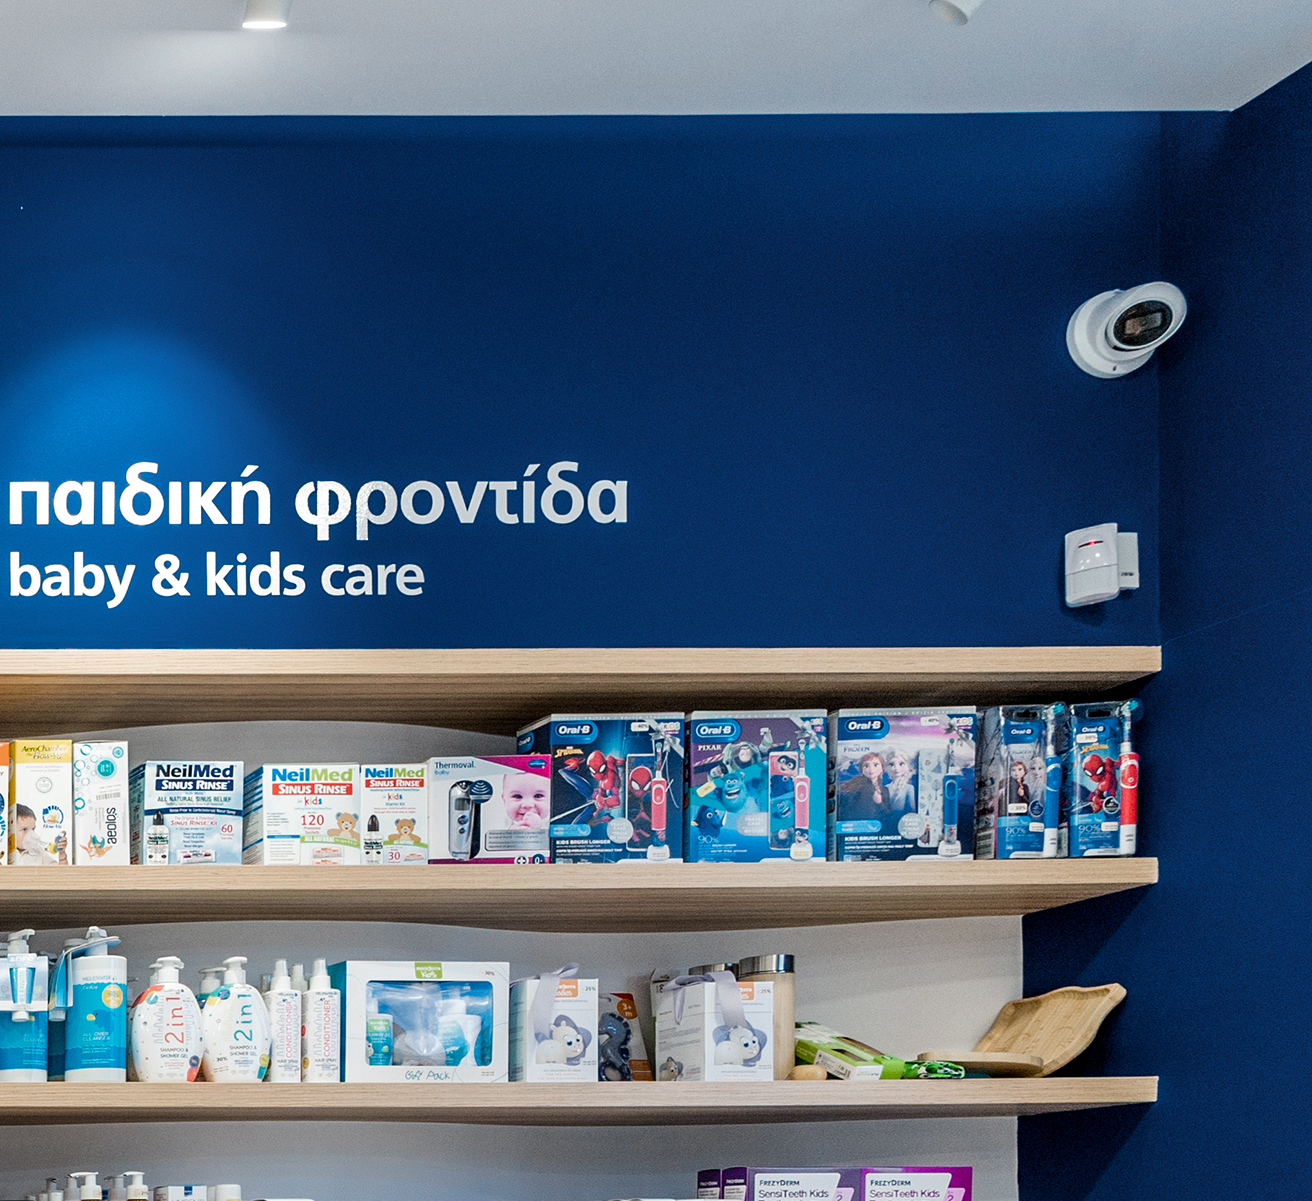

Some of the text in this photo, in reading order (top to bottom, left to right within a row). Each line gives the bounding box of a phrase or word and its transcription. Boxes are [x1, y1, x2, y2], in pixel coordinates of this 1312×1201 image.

[9, 461, 628, 541] παιδική φροντίδα
[9, 551, 425, 609] baby & kids care
[561, 725, 592, 735] Oral-B
[700, 725, 731, 735] Oral-B
[848, 720, 881, 731] Oral-B
[435, 761, 475, 770] Thermoval
[156, 764, 234, 778] NeilMed
[272, 767, 354, 782] NeilMed
[365, 768, 425, 778] NeilMed
[161, 780, 230, 790] SINUS RINSE
[277, 784, 347, 794] SINUS RINSE
[395, 780, 421, 788] RINSE
[300, 814, 324, 826] 120
[106, 806, 118, 845] aeolos
[221, 824, 233, 833] 60
[388, 851, 400, 861] 30
[285, 1000, 293, 1058] CONDITIONER
[323, 999, 331, 1058] CONDITIONER
[758, 1189, 829, 1198] SensiTeeth Kids
[869, 1189, 940, 1198] SensiTeeth Kids
